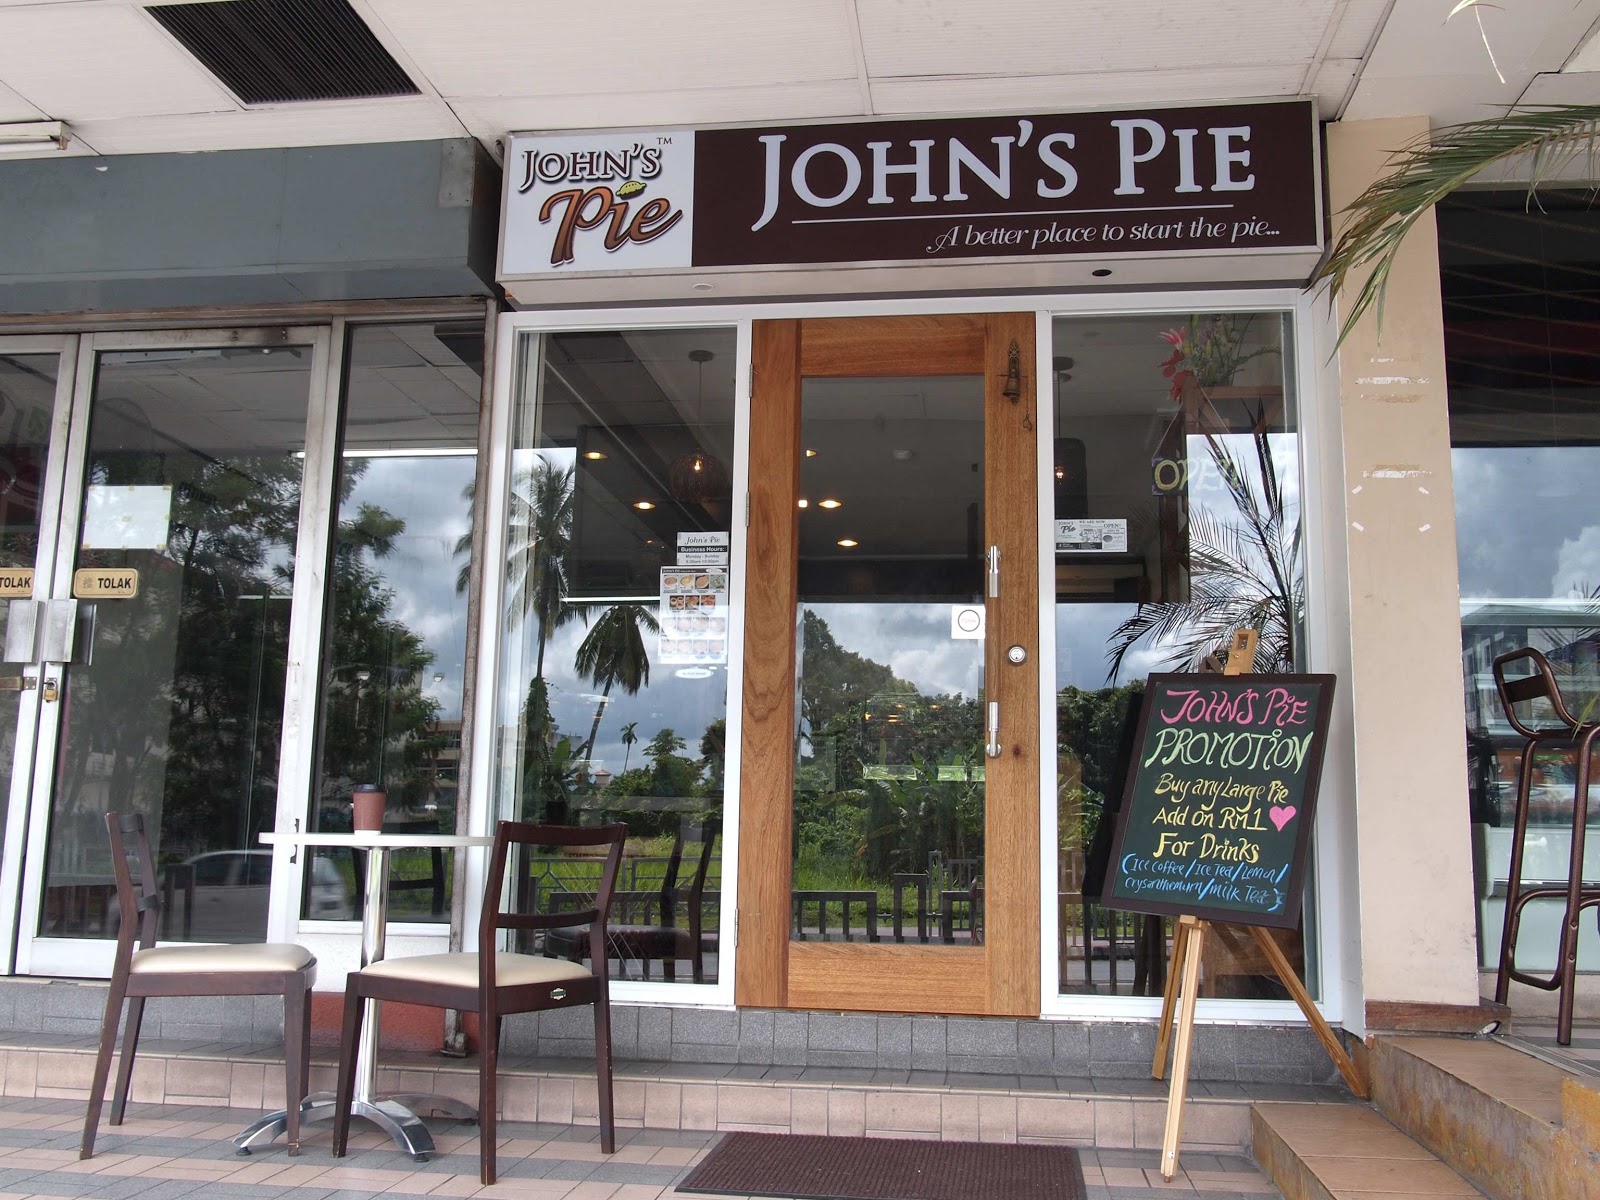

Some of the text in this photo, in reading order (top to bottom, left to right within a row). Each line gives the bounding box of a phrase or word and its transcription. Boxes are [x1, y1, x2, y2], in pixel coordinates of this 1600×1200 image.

[518, 143, 663, 194] JOHN'S
[751, 118, 1255, 232] JOHN'S PIE
[538, 186, 683, 267] Pie
[925, 215, 1280, 254] A better place to start the pie...
[684, 535, 721, 545] John's Pie
[1060, 525, 1077, 534] Pie
[0, 577, 31, 588] TOLAK
[97, 577, 132, 589] TOLAK
[1154, 772, 1290, 813] Buy any Large Pie
[1152, 805, 1190, 827] Add
[1152, 832, 1260, 864] For Drinks
